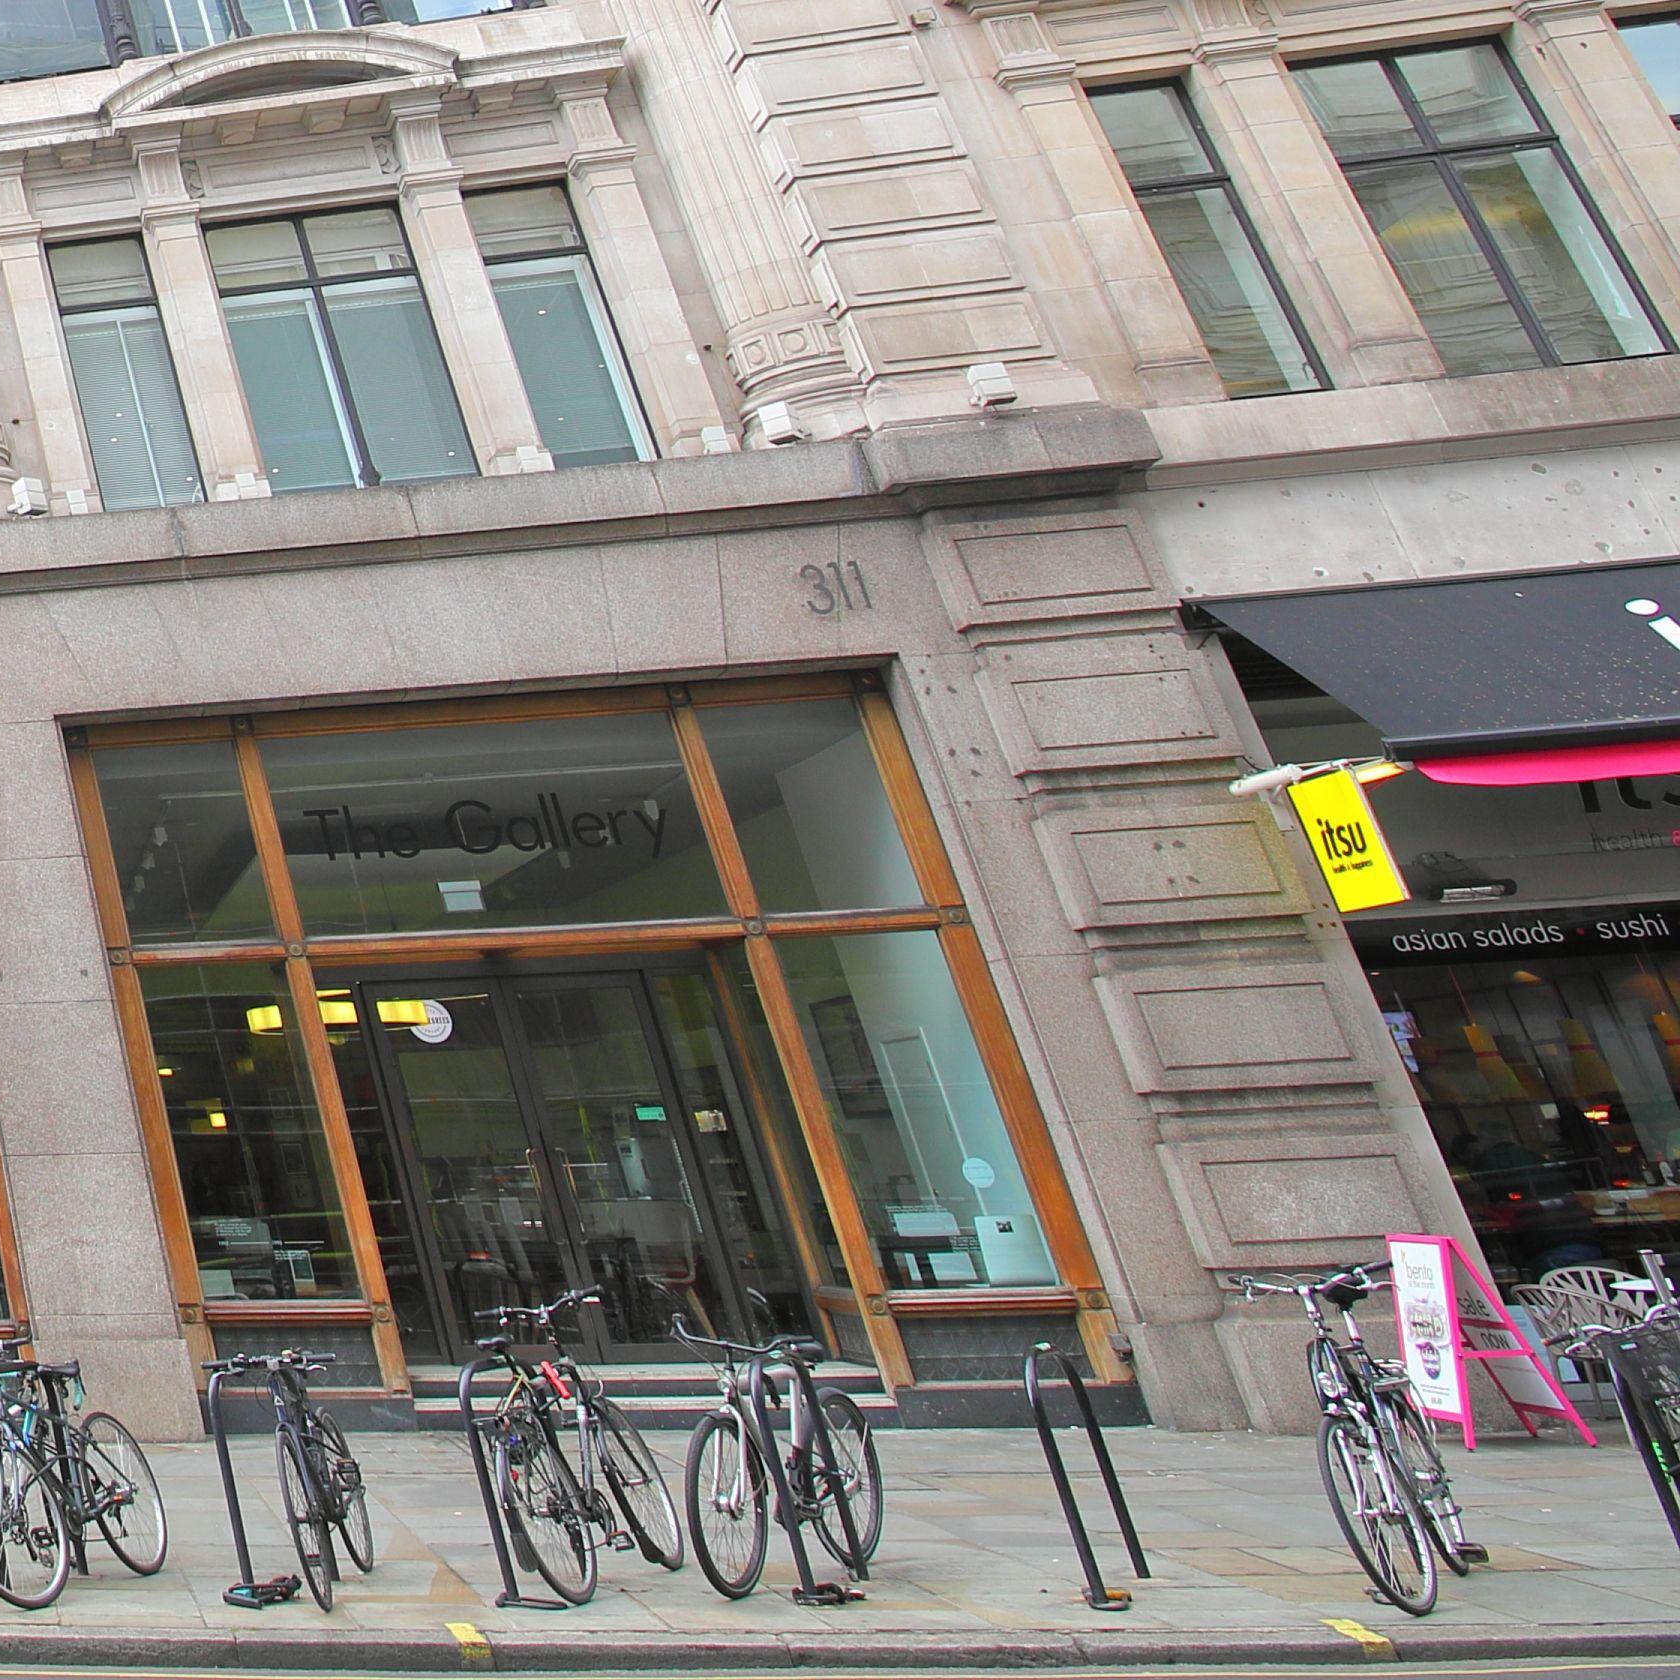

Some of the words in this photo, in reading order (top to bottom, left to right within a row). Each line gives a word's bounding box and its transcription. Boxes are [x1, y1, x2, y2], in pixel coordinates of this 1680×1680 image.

[800, 560, 872, 615] 311
[302, 804, 422, 862] The
[444, 792, 667, 860] Gallery
[1316, 818, 1368, 860] itsu
[1392, 928, 1467, 953] asian
[1472, 920, 1565, 948] salads
[1595, 913, 1670, 940] sushi
[1405, 1261, 1434, 1280] bento
[1457, 1289, 1490, 1317] sale
[1481, 1332, 1511, 1350] now
